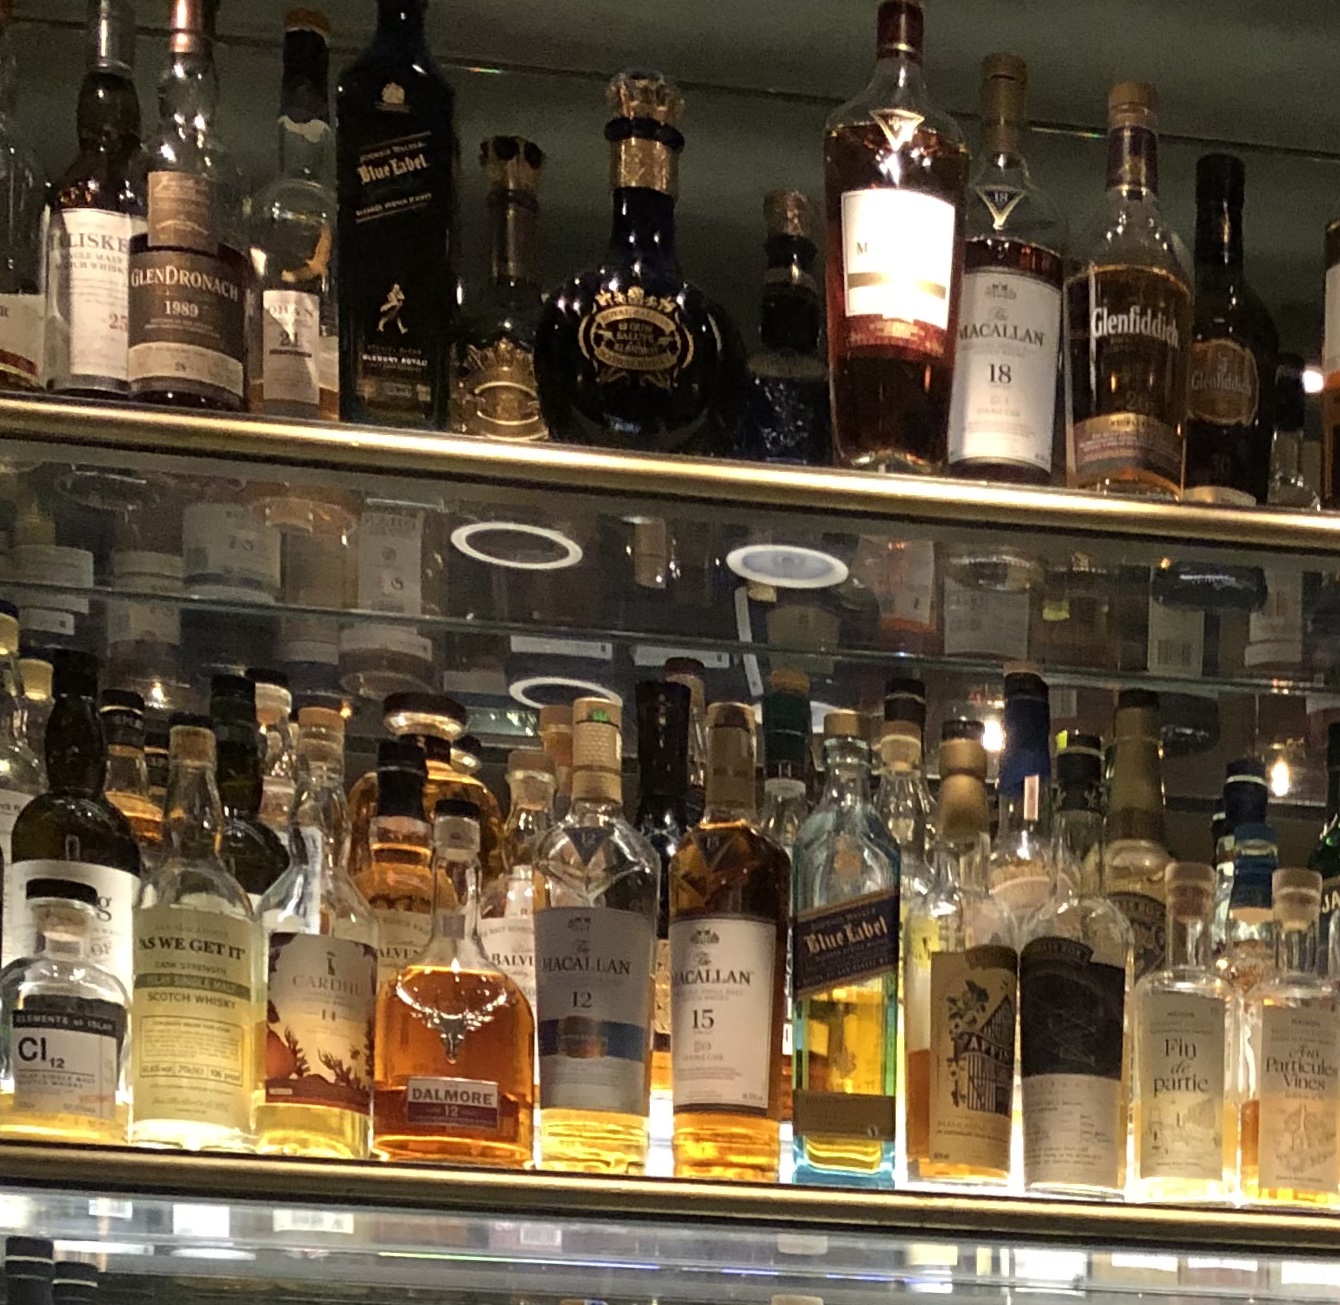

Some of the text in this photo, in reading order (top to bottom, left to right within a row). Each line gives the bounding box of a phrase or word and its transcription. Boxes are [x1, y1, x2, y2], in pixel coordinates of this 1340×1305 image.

[356, 153, 431, 186] Blue Label
[50, 232, 129, 255] LISKE
[164, 300, 199, 318] 1989
[958, 322, 1045, 348] MACALLAN
[1092, 305, 1179, 349] Glenfiddich
[986, 362, 1013, 385] 18
[1191, 370, 1252, 395] Glenfiddich
[803, 931, 844, 957] Blue
[843, 914, 888, 946] Label
[158, 937, 186, 951] WE
[189, 939, 226, 959] GET
[147, 991, 237, 1010] SCOTCH WHISKY
[570, 991, 592, 1008] 12
[691, 1008, 715, 1030] 15
[1164, 1038, 1197, 1059] Fin
[1266, 1056, 1338, 1078] Particules
[1153, 1075, 1209, 1096] partie
[1283, 1073, 1326, 1091] Vines
[412, 1087, 493, 1105] DALMORE
